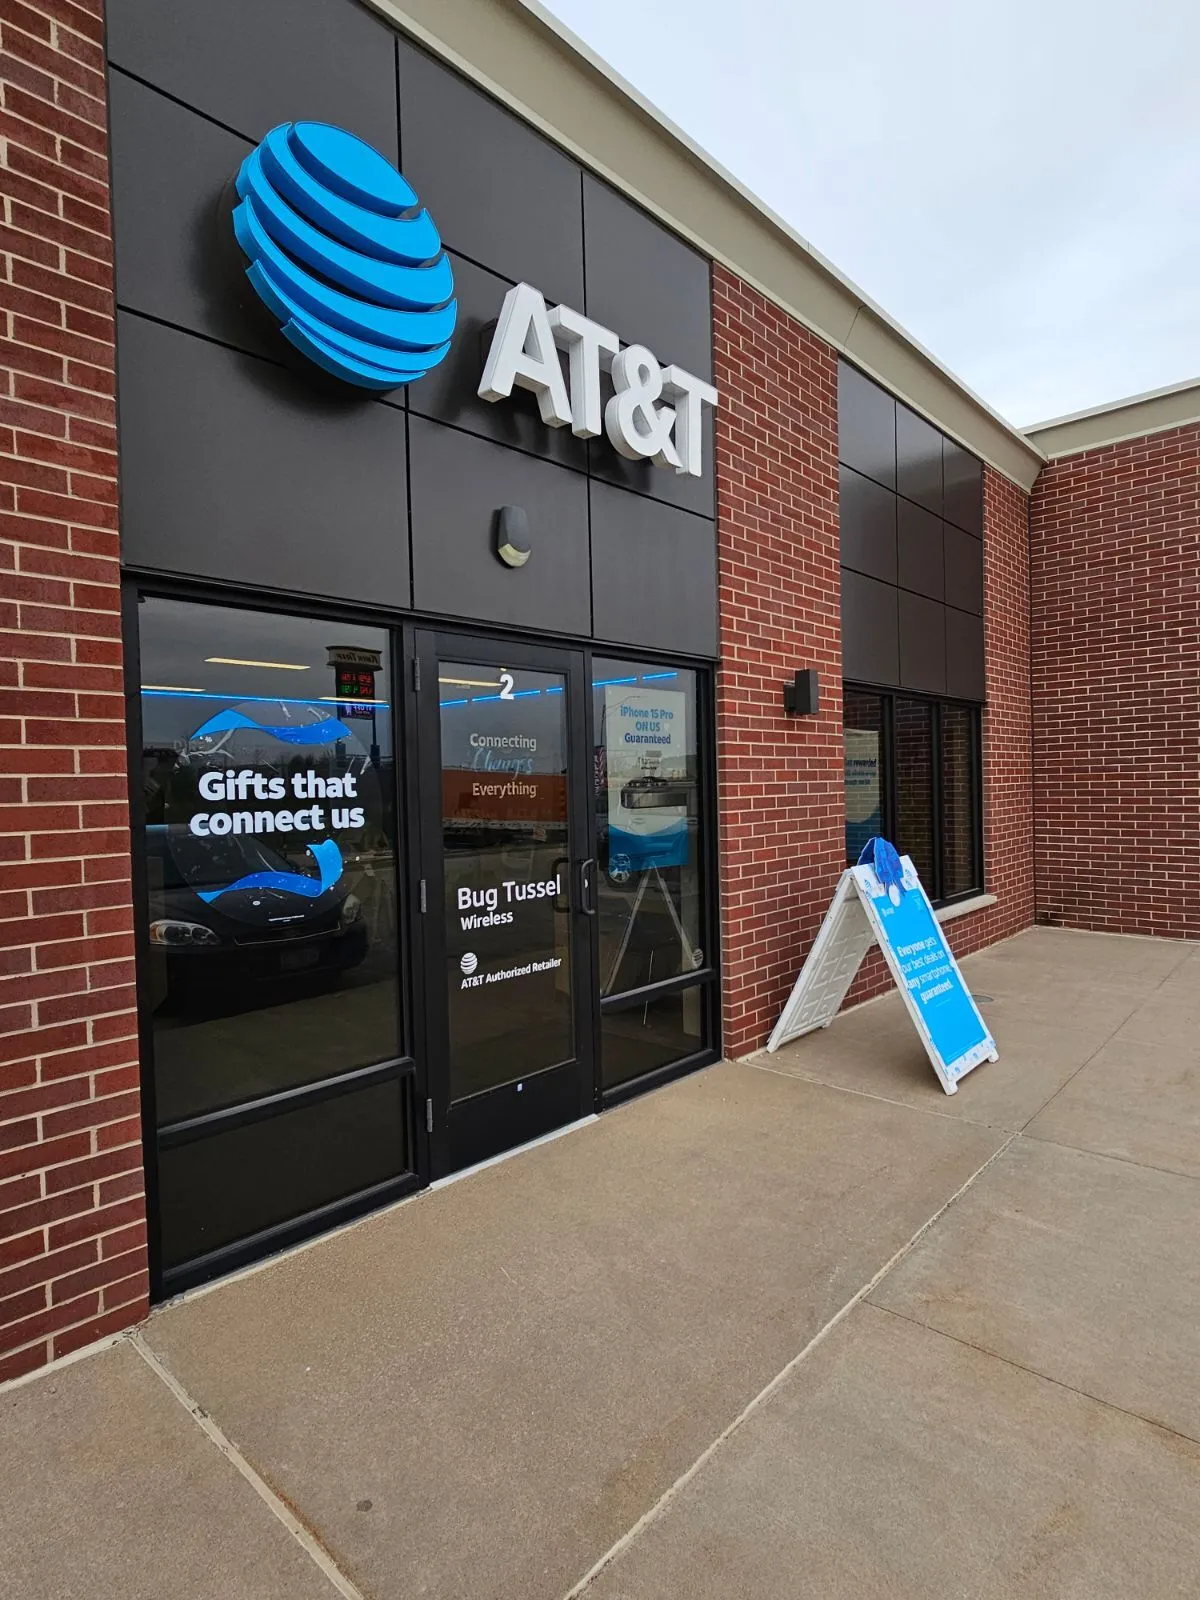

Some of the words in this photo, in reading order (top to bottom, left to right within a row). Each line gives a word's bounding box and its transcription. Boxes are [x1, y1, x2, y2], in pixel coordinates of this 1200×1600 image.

[477, 281, 719, 478] AT&T
[500, 673, 514, 700] 2
[620, 704, 648, 718] iPhone
[650, 708, 659, 719] 15
[660, 709, 674, 719] Pro
[624, 732, 671, 744] Guaranteed
[635, 721, 649, 731] ON
[650, 721, 661, 732] US
[470, 733, 537, 752] Connecting
[198, 769, 286, 801] Gifts
[291, 769, 358, 799] that
[472, 781, 537, 799] Everything
[190, 804, 326, 837] connect
[331, 807, 365, 829] us
[457, 887, 498, 911] Bug
[502, 873, 561, 902] Tussel
[460, 911, 514, 931] Wireless
[896, 941, 926, 957] Everyone
[924, 936, 937, 951] gets
[901, 963, 912, 974] our
[911, 955, 925, 970] best
[923, 951, 938, 965] deals
[936, 949, 946, 960] on
[460, 974, 485, 990] AT&T
[485, 963, 532, 984] Authorized
[532, 957, 562, 972] Retailer
